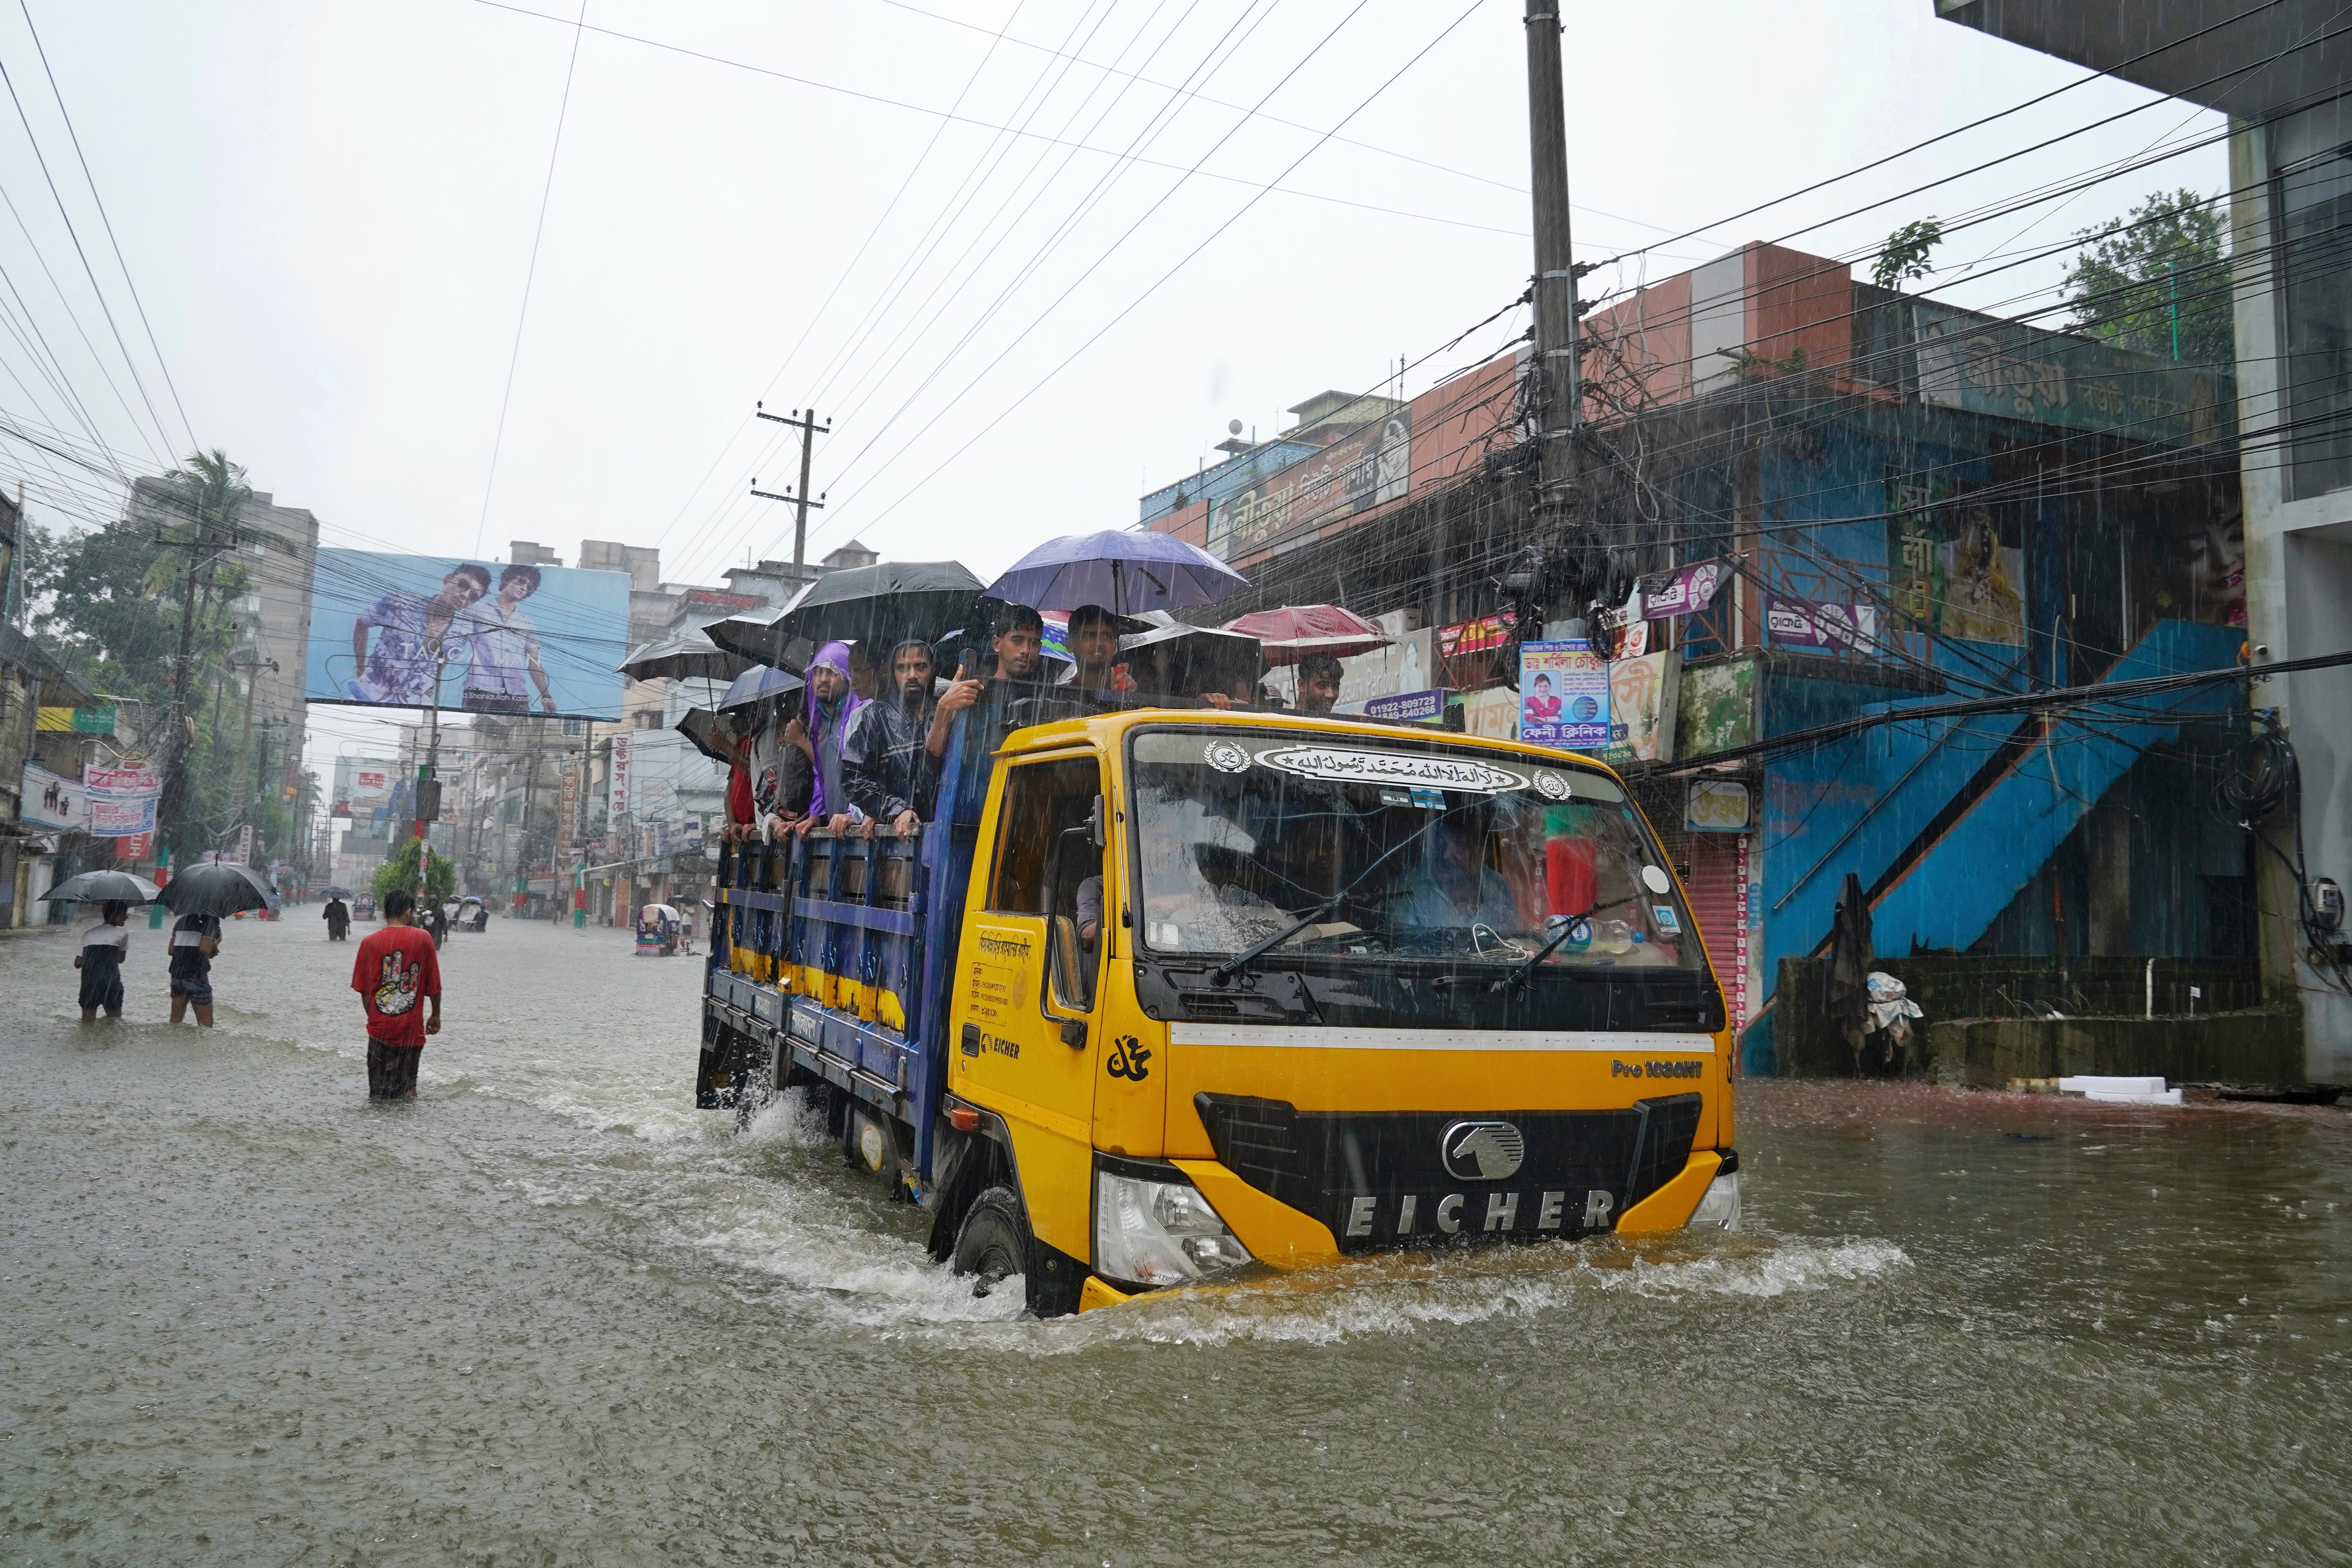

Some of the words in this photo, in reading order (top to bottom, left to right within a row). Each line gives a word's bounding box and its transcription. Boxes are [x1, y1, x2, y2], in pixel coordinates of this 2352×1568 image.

[495, 653, 541, 668] MAN
[1523, 657, 1540, 669] ডাঃ
[1542, 652, 1572, 669] শর্মিলা
[469, 692, 510, 701] Shahidullah
[1370, 696, 1435, 715] 01922-809729
[1523, 725, 1557, 738] ফেনী
[1560, 724, 1607, 738] ক্লিনিক
[993, 1037, 1020, 1060] EICHER
[1611, 1059, 1643, 1078] Pro
[1644, 1060, 1703, 1078] 1080HT
[1346, 1189, 1614, 1237] EICHER
